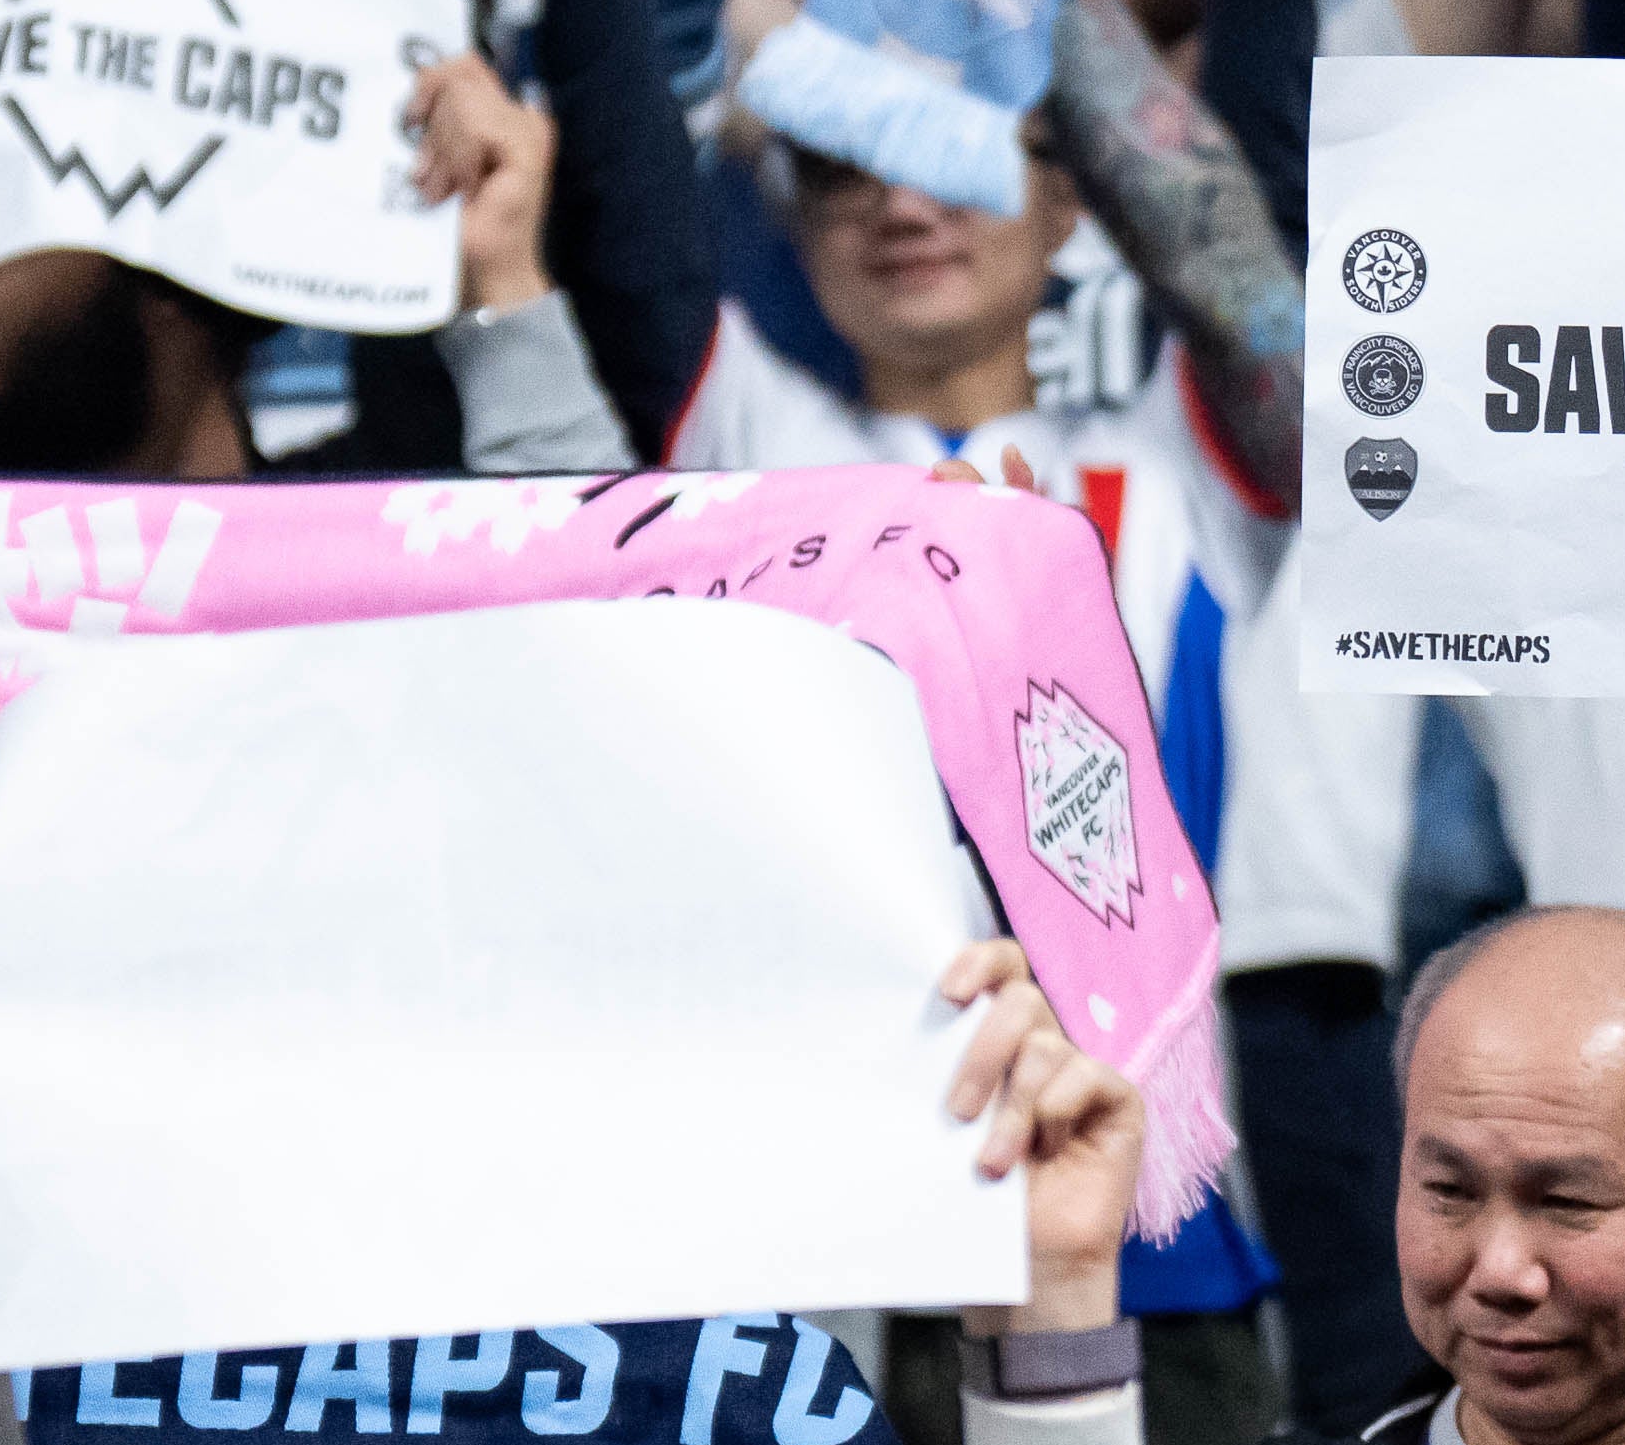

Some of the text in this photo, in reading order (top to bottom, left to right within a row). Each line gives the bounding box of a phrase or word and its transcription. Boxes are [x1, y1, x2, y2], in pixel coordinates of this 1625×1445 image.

[68, 22, 159, 90] THE
[176, 38, 346, 144] CAPS
[1346, 231, 1421, 259] VANCOUVER
[1345, 279, 1423, 311] SOUTH SIDERS
[1347, 337, 1420, 372] RAINCITY BRIGADE
[1346, 382, 1421, 415] VANCOUVER BC
[1334, 630, 1551, 665] #SAVETHECAPS
[1043, 753, 1100, 809] VANCOUVER
[1034, 756, 1122, 850] WHITECAPS
[1080, 814, 1104, 846] FC
